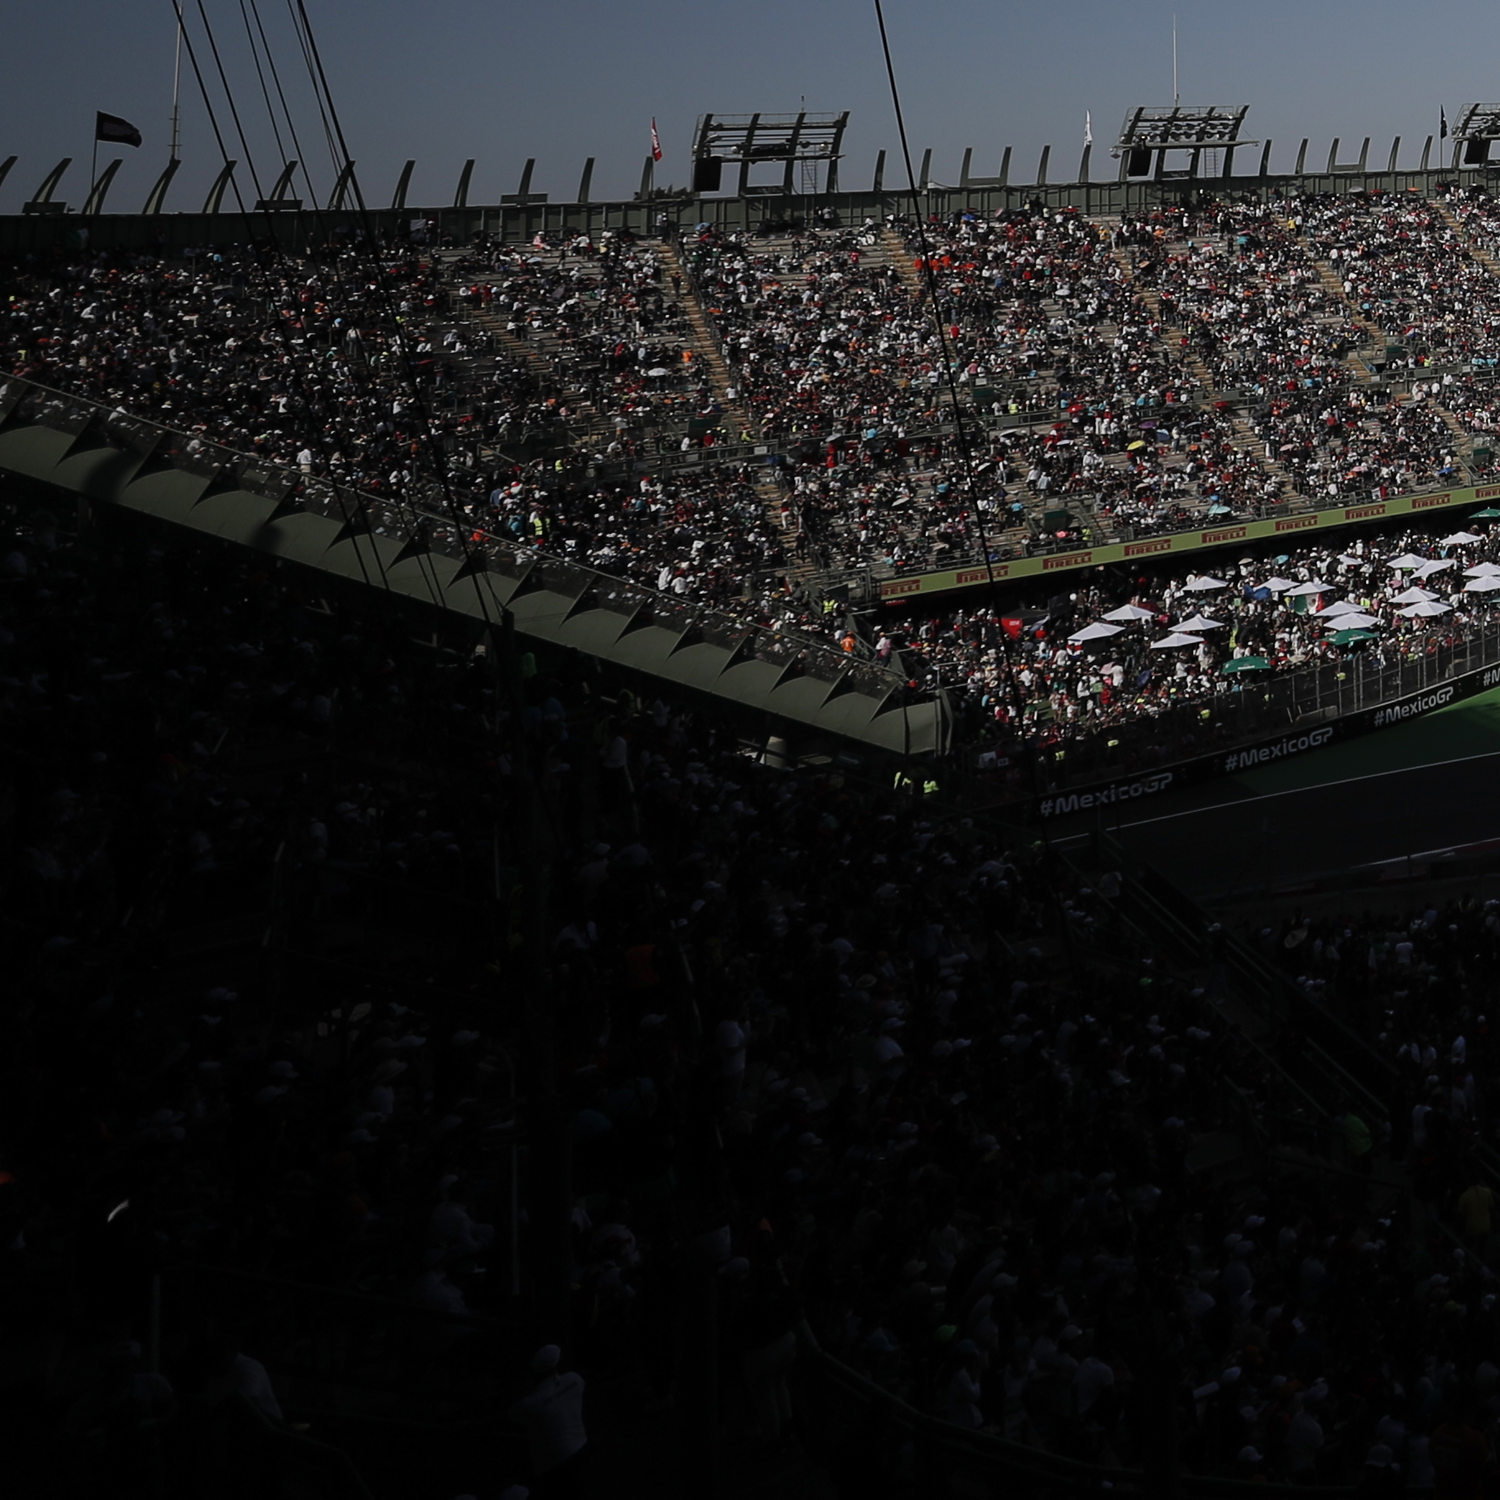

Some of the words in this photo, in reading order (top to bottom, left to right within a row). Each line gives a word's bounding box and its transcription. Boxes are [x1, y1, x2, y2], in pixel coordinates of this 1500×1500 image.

[1412, 494, 1450, 509] PIRELLI
[1346, 504, 1385, 520] PIRELLI
[1276, 515, 1317, 531] PIRELLI
[1202, 526, 1246, 543] PIRELLI
[1124, 539, 1171, 556] PIRELLI
[1043, 552, 1092, 569] PIRELLI
[957, 566, 1008, 583] PIRELLI
[1374, 687, 1454, 727] #MexicoGP
[1224, 727, 1334, 772] #MexicoGP
[1039, 772, 1173, 818] #MexicoGP
